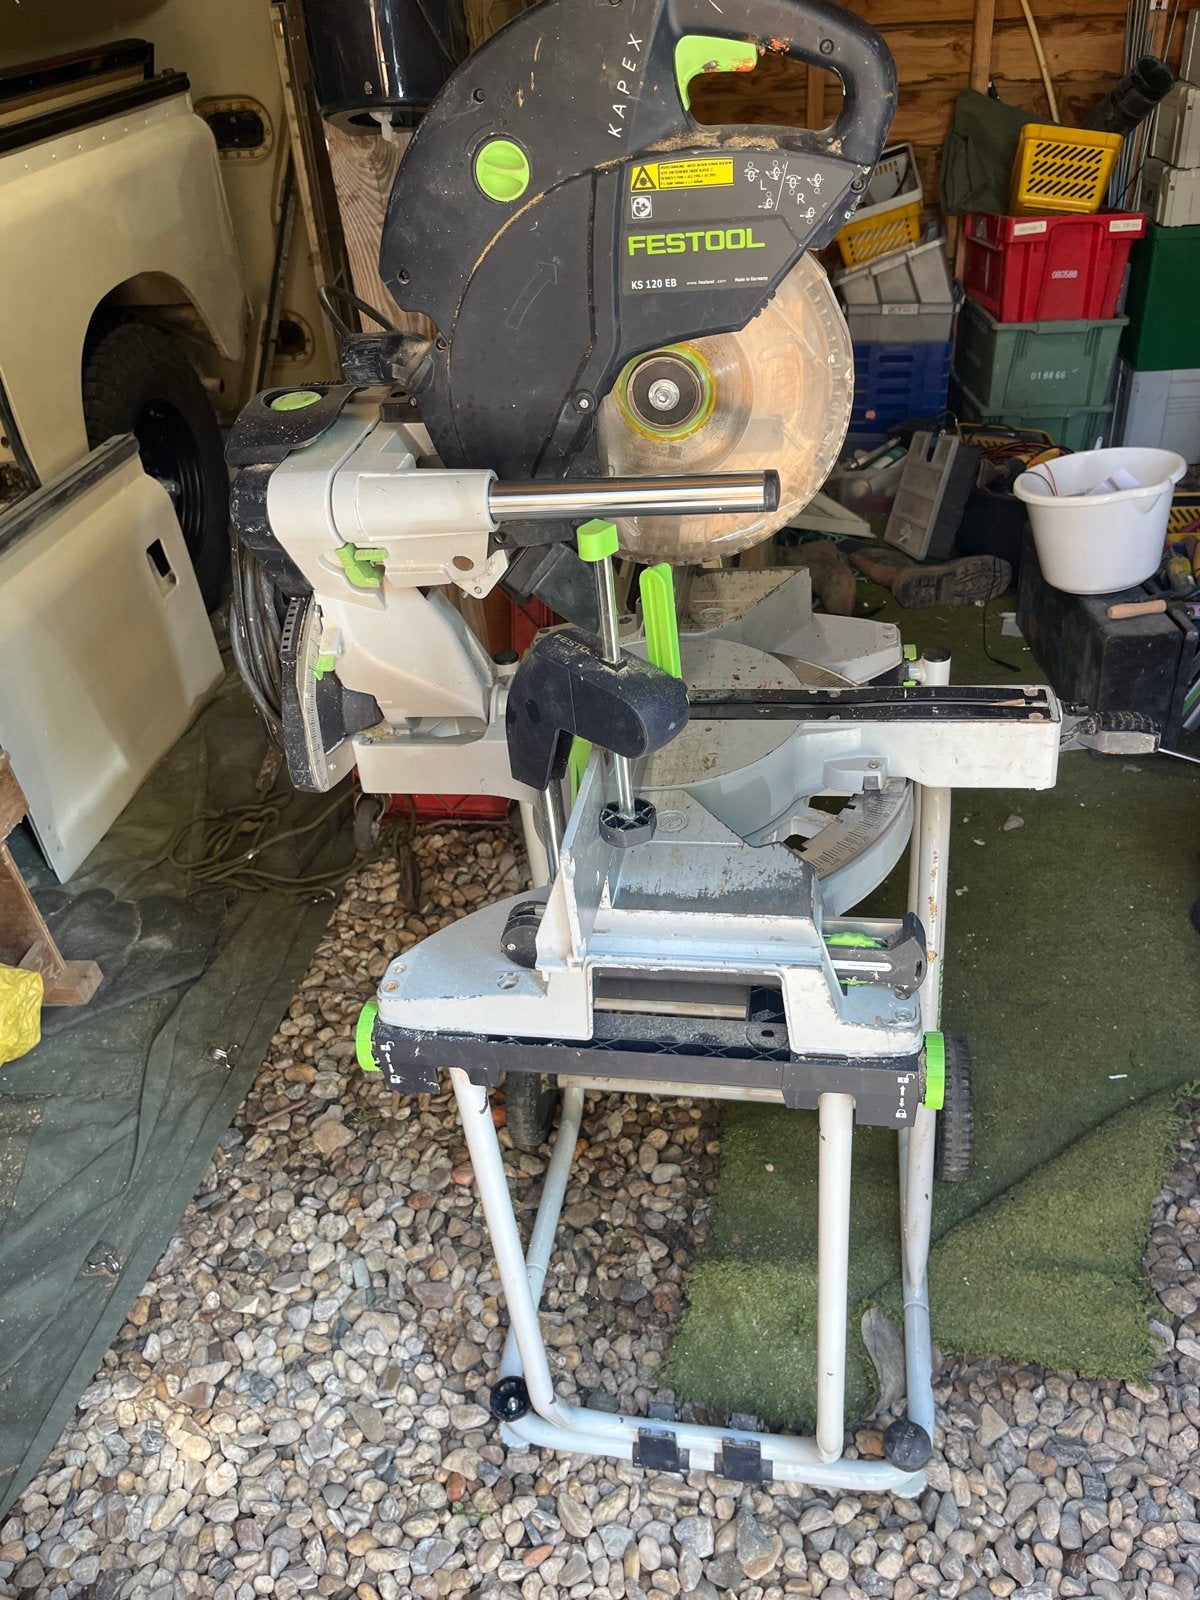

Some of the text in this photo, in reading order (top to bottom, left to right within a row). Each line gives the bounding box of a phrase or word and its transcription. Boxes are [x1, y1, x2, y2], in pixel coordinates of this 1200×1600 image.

[608, 33, 642, 138] KAPEX
[797, 193, 805, 204] R
[628, 228, 765, 256] FESTOOL
[631, 278, 677, 290] KS 120 EB
